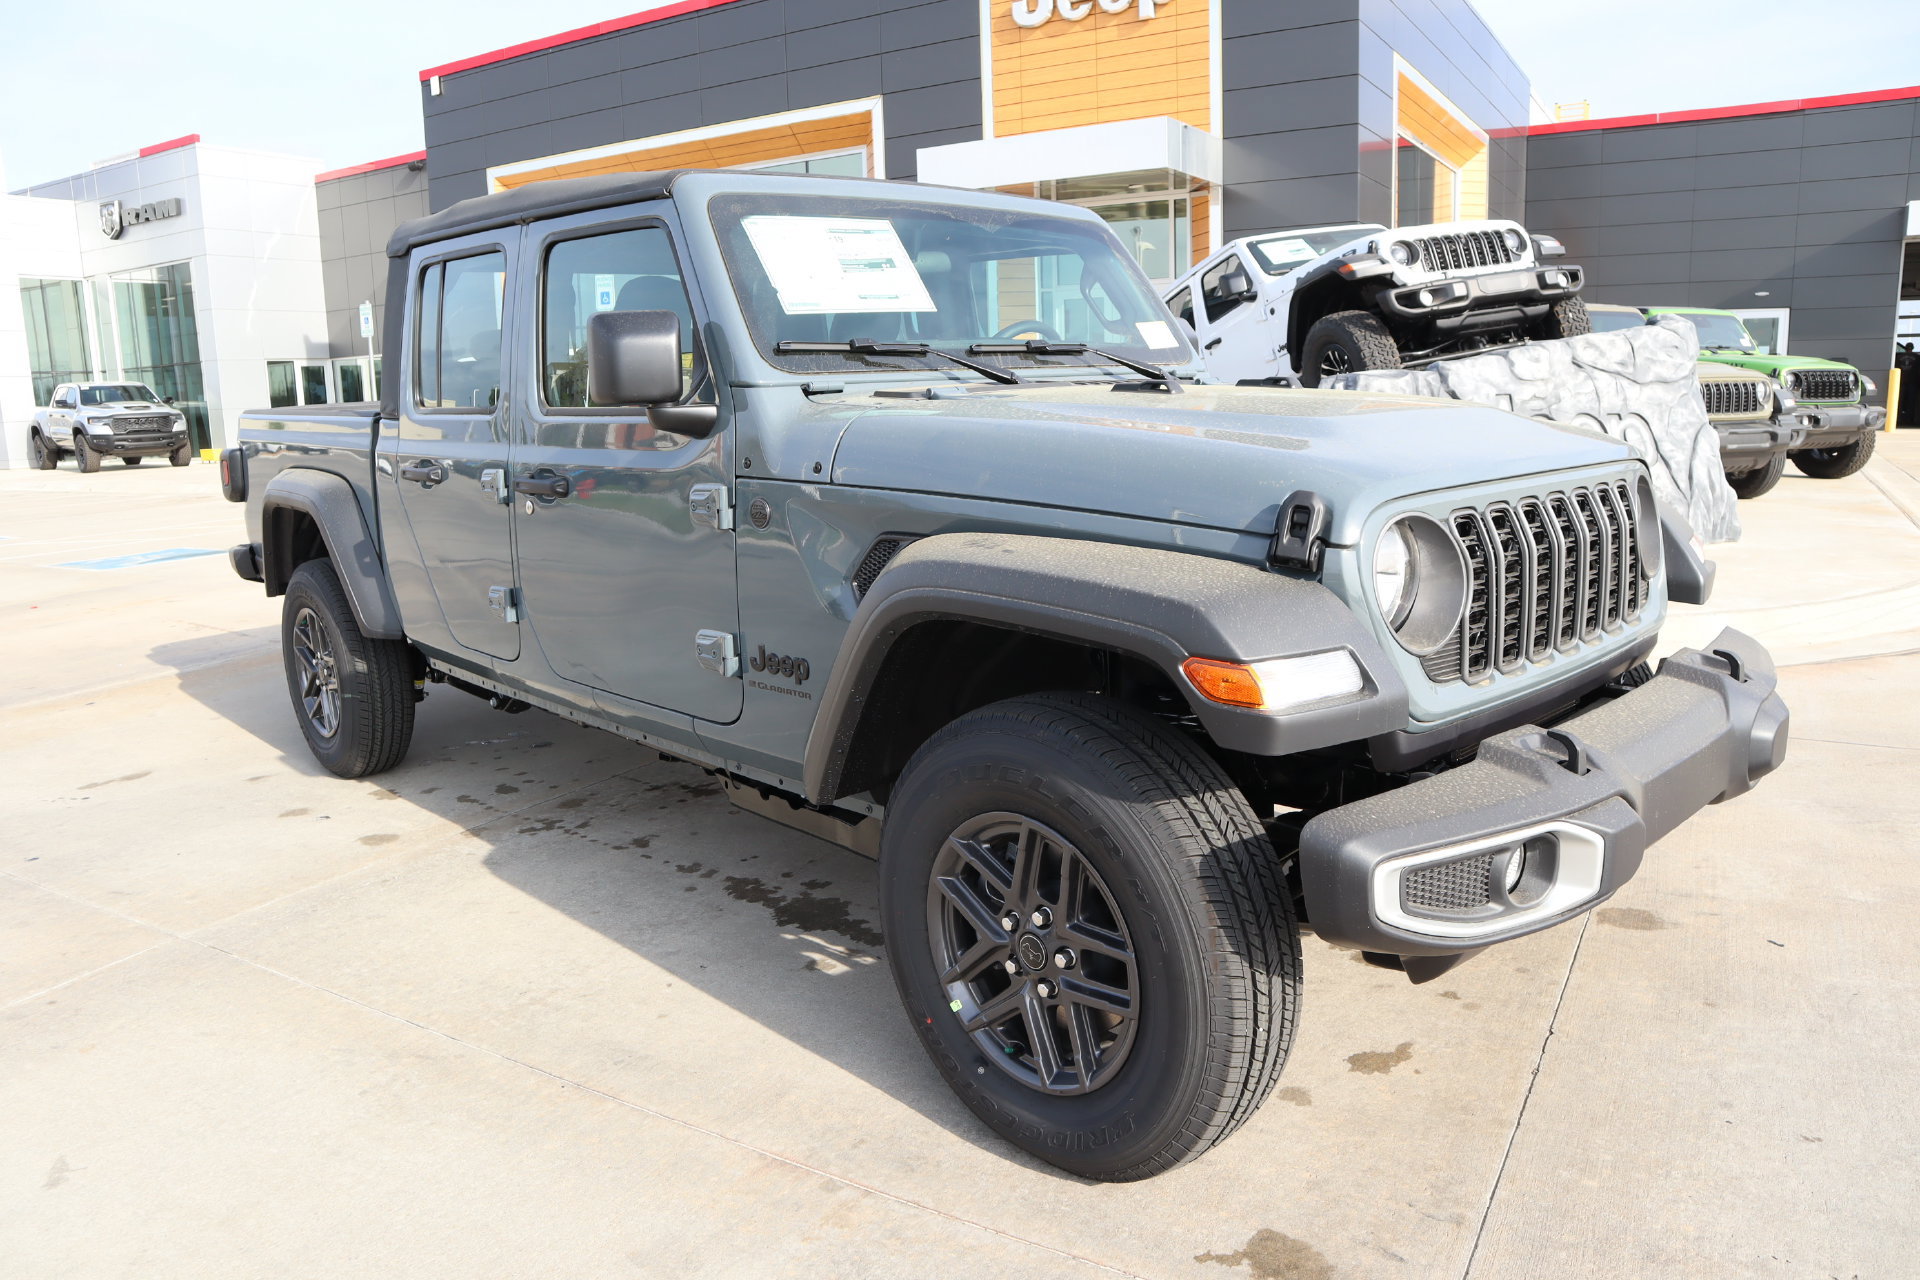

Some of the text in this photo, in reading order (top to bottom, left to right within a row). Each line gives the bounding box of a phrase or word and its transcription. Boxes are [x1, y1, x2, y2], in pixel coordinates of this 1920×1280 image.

[121, 197, 181, 226] RAM
[749, 644, 810, 686] Jeep
[757, 681, 812, 701] GLADIATOR
